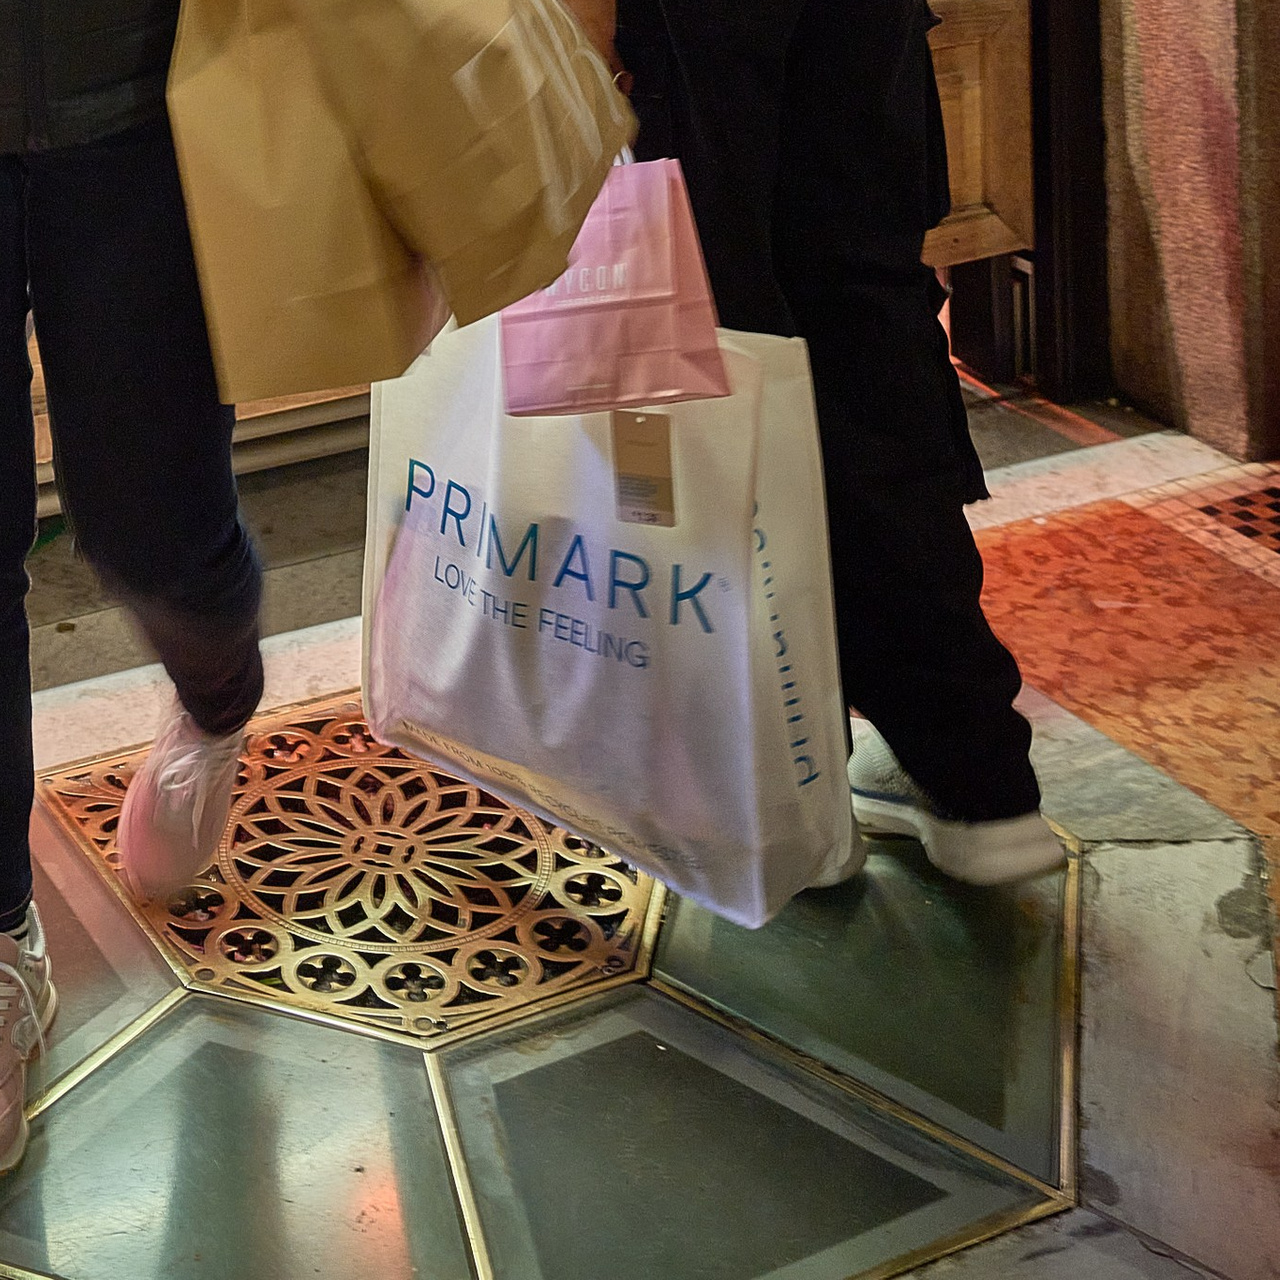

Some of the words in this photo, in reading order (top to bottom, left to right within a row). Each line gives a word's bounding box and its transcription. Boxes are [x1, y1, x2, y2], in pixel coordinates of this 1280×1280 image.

[405, 457, 716, 635] PRIMARK
[434, 555, 477, 607] LOVE
[479, 589, 527, 629] THE
[538, 607, 650, 669] FEELING
